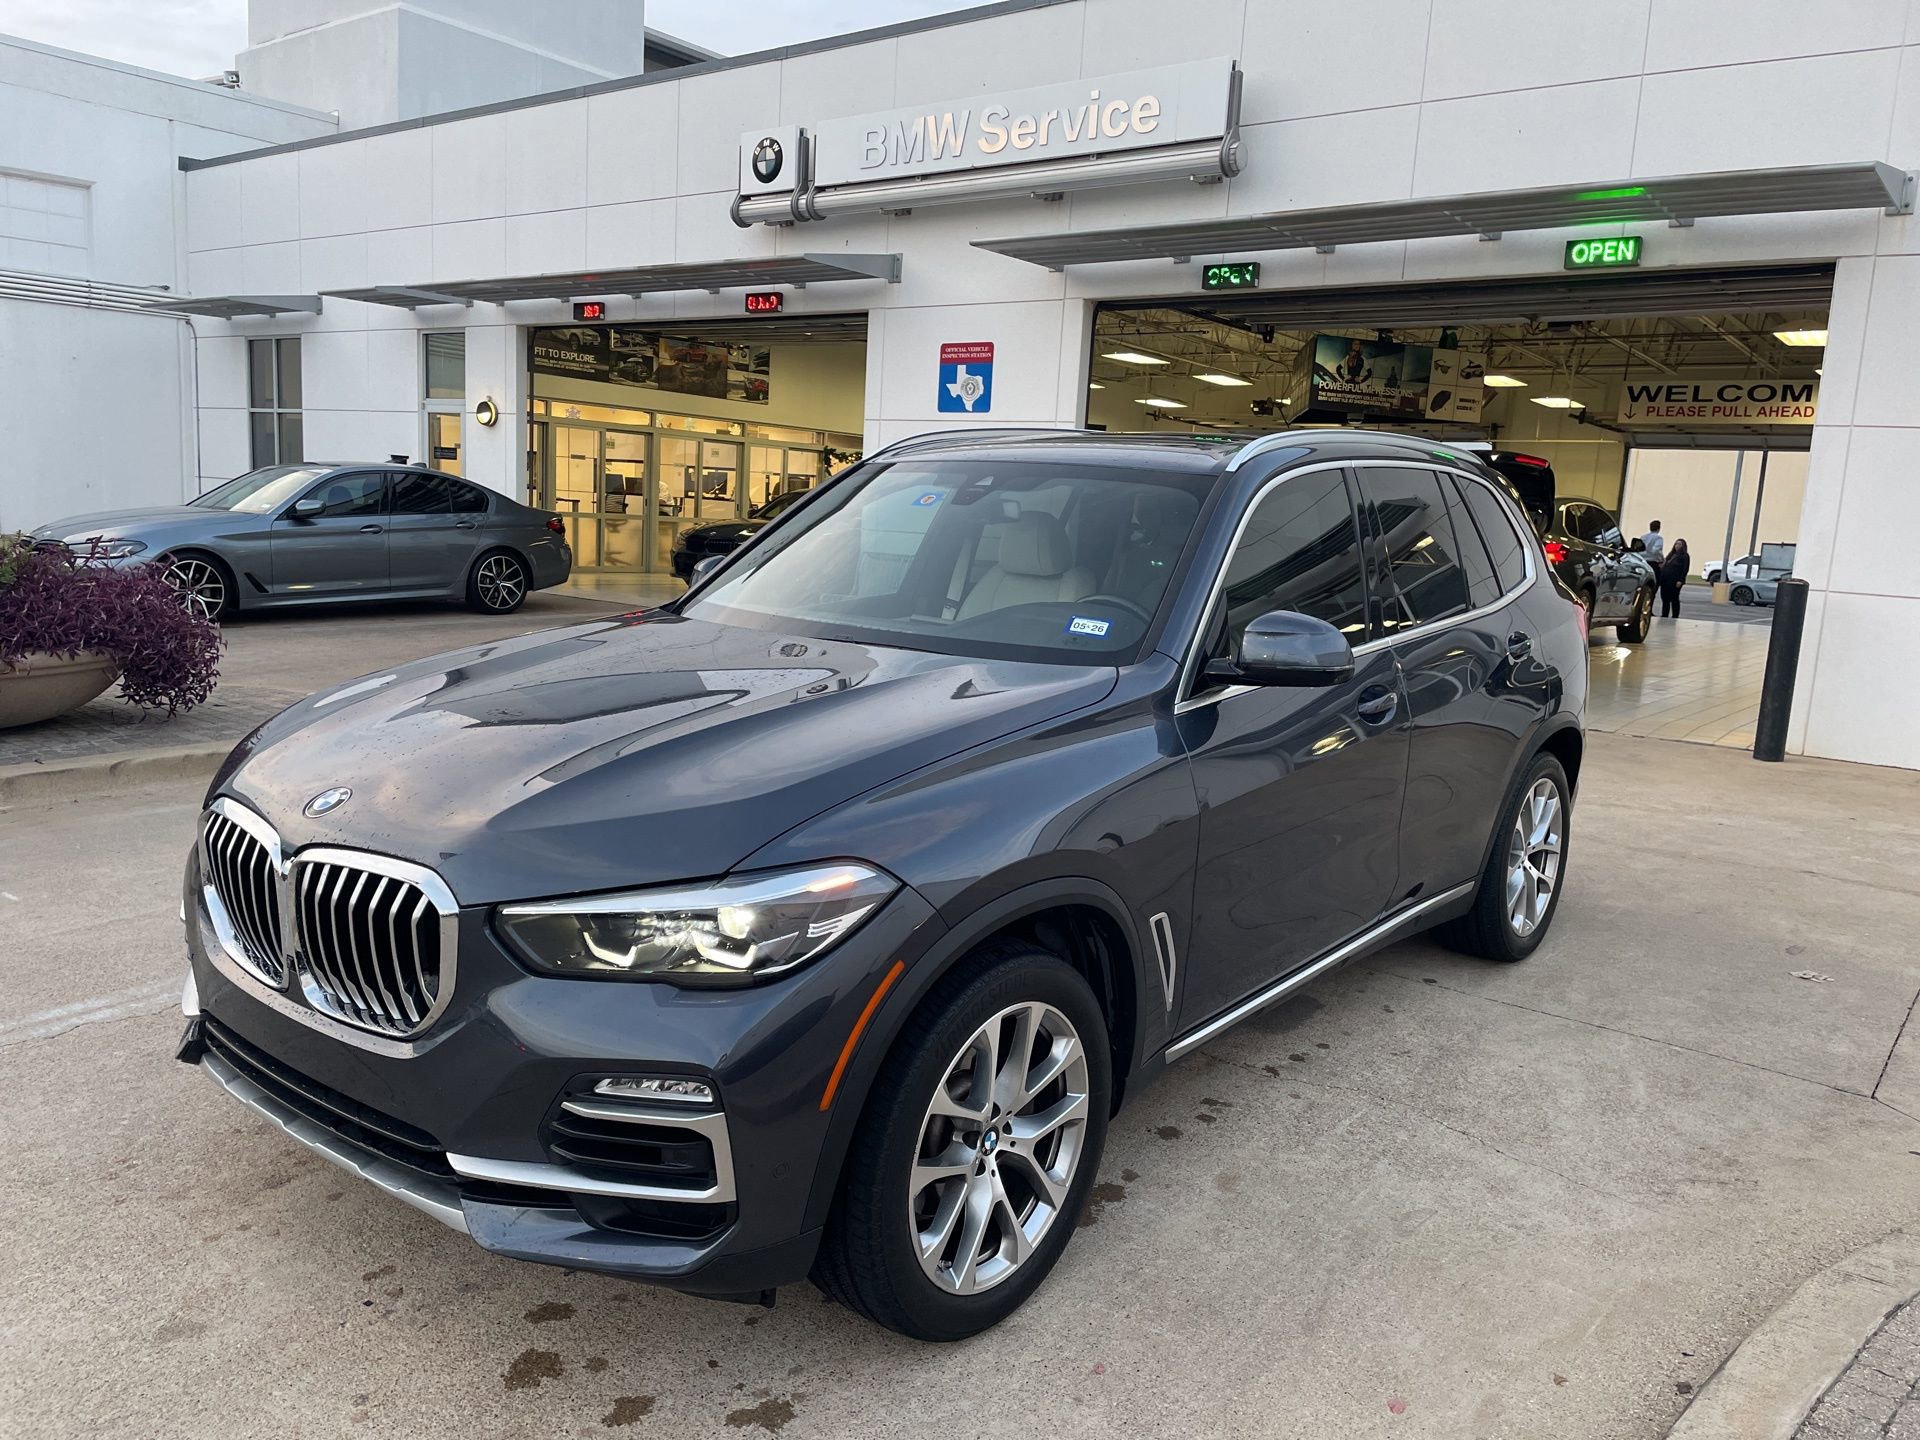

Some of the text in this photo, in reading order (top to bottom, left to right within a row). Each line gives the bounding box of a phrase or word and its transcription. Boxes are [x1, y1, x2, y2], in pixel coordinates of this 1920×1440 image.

[860, 89, 1161, 170] BMW Service
[754, 138, 780, 156] BMW
[1572, 240, 1635, 264] OPEN
[534, 346, 546, 356] FIT
[548, 348, 559, 358] TO
[1318, 380, 1362, 393] POWERFUL
[1627, 384, 1814, 403] WELCOM
[1646, 405, 1815, 418] PLEASE PULL AHEAD
